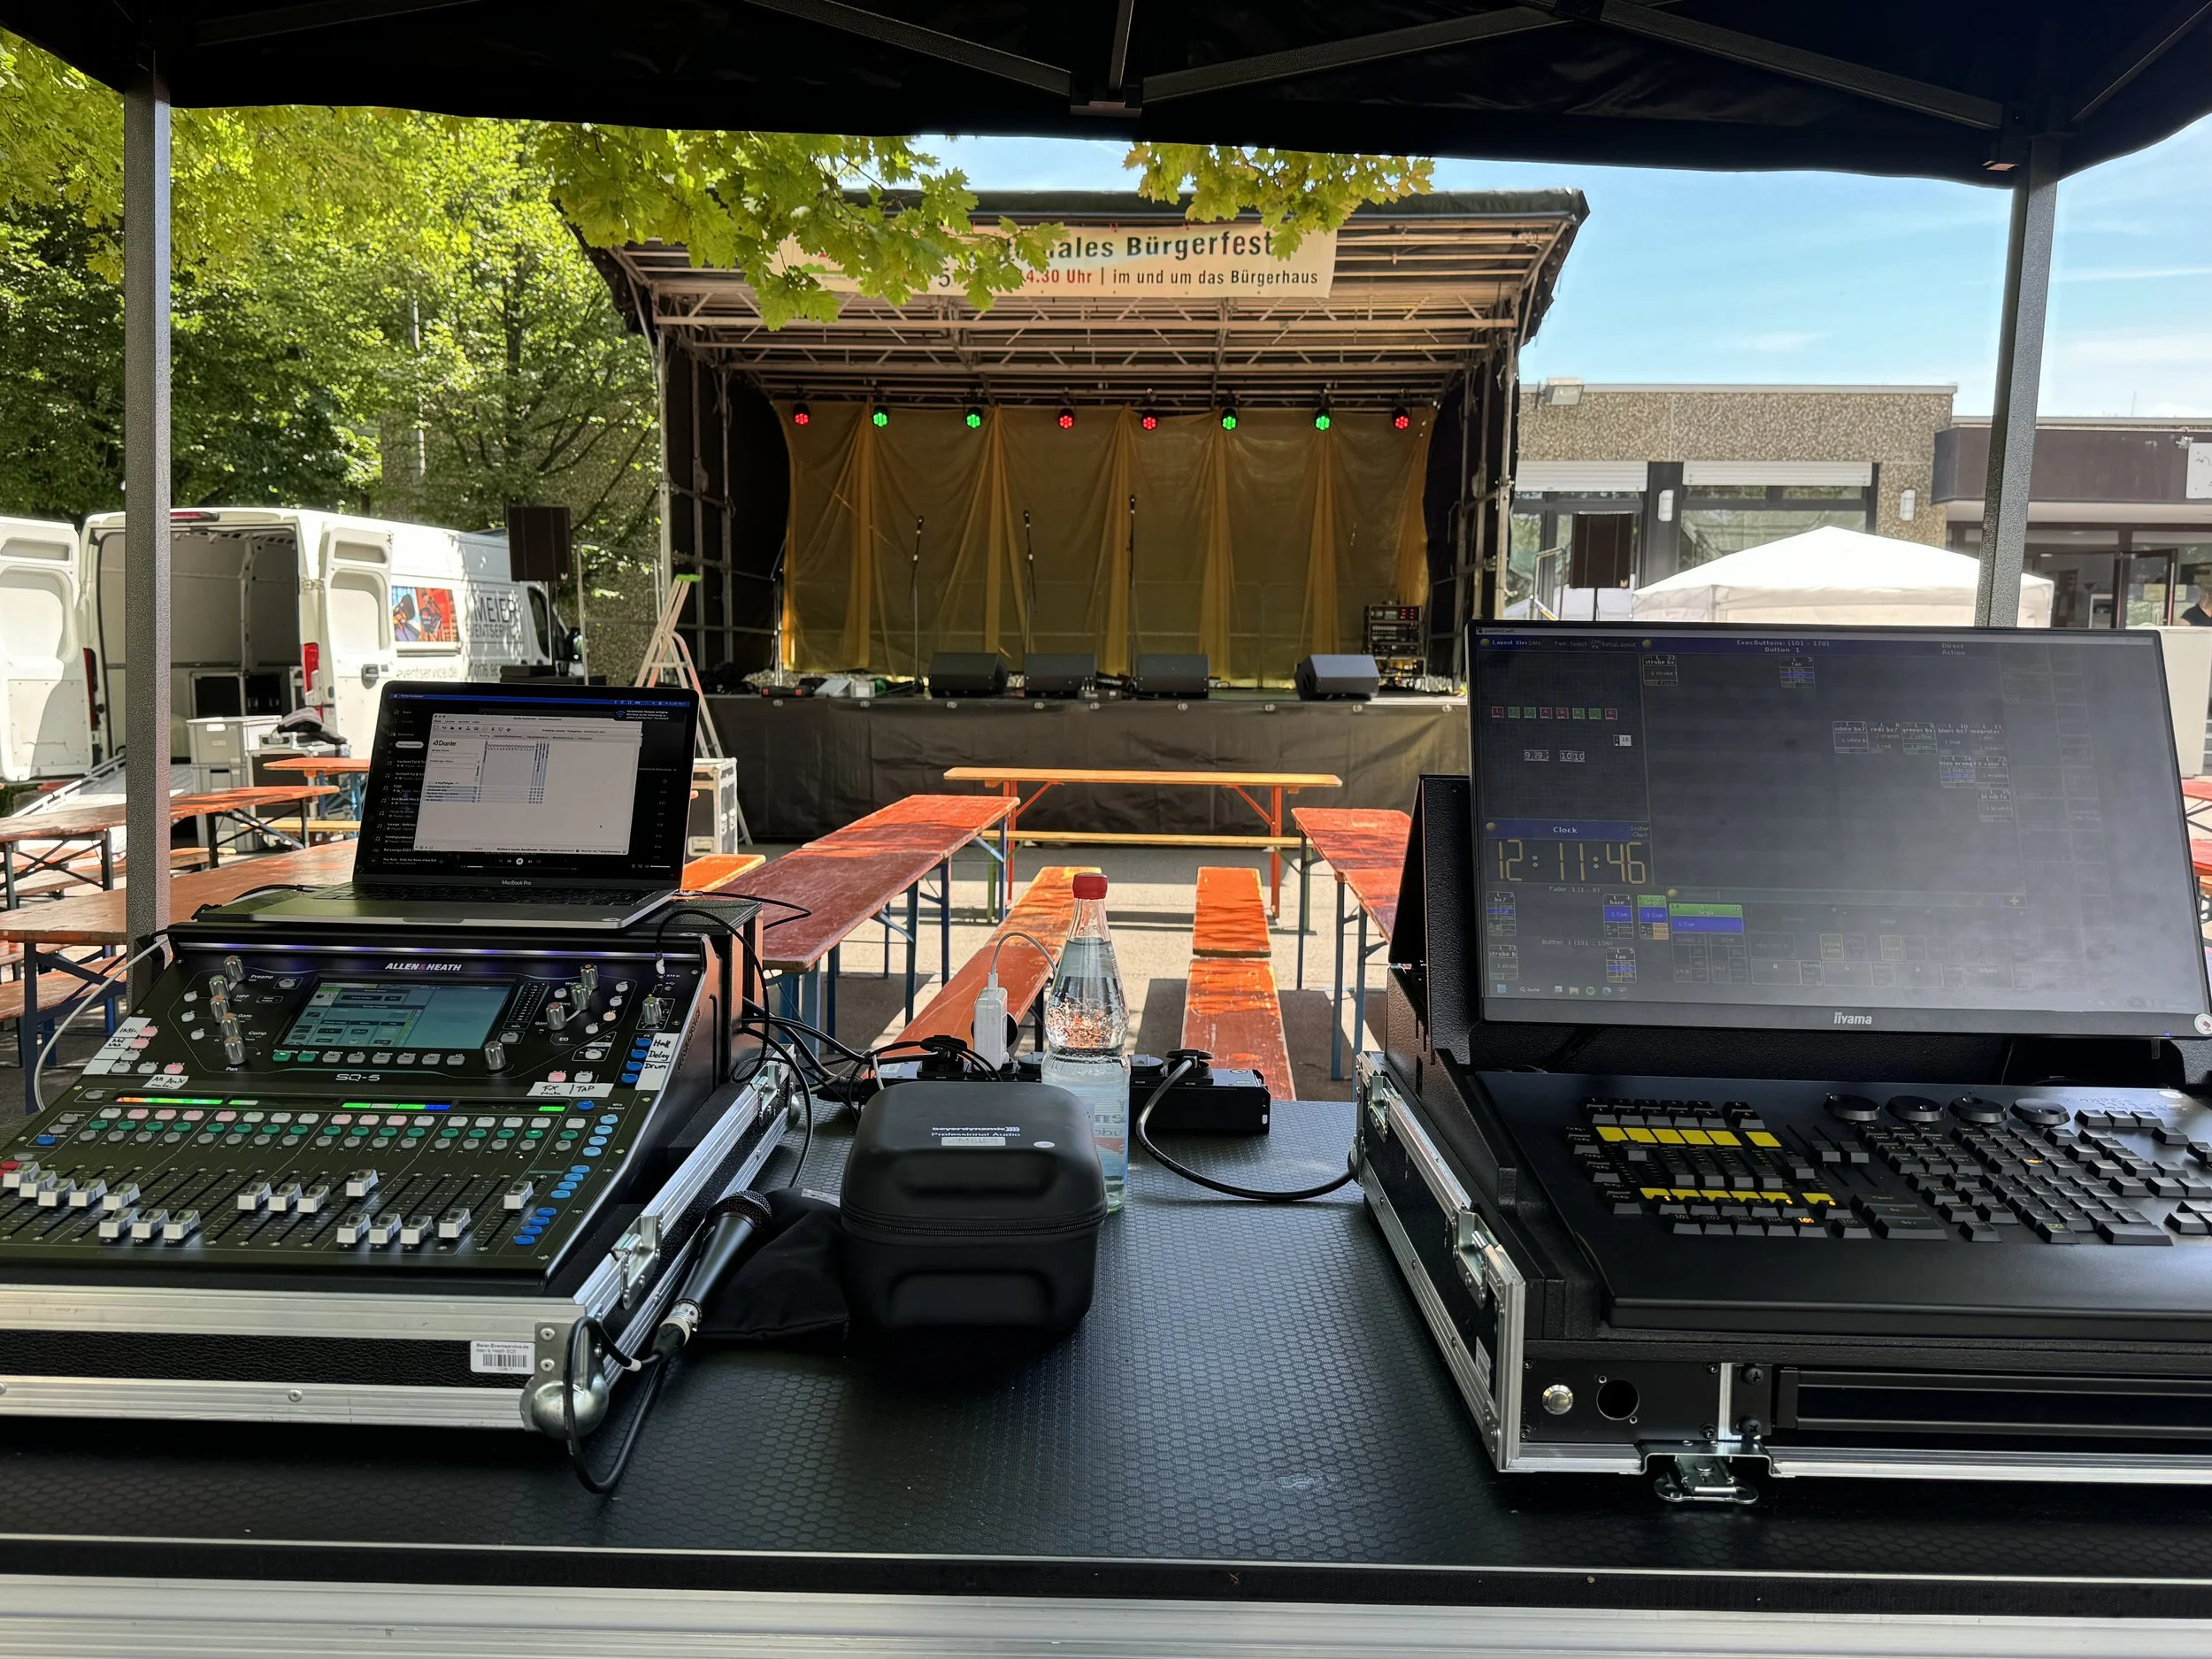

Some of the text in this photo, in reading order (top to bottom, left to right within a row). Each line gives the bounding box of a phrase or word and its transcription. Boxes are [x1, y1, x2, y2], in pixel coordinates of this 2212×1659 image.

[1126, 231, 1272, 260] Bürgerfest
[1066, 269, 1093, 284] Uhr
[1113, 269, 1130, 284] im
[1137, 269, 1164, 284] und
[1171, 273, 1192, 284] um
[1198, 270, 1225, 284] das
[1231, 269, 1318, 288] Bürgerhaus
[1552, 826, 1578, 834] Clock
[385, 963, 462, 972] ALLEN&HEATH
[648, 1049, 670, 1062] Delay
[644, 1062, 667, 1071] Drum
[334, 1073, 380, 1082] SQ-5
[576, 1085, 595, 1094] TAP
